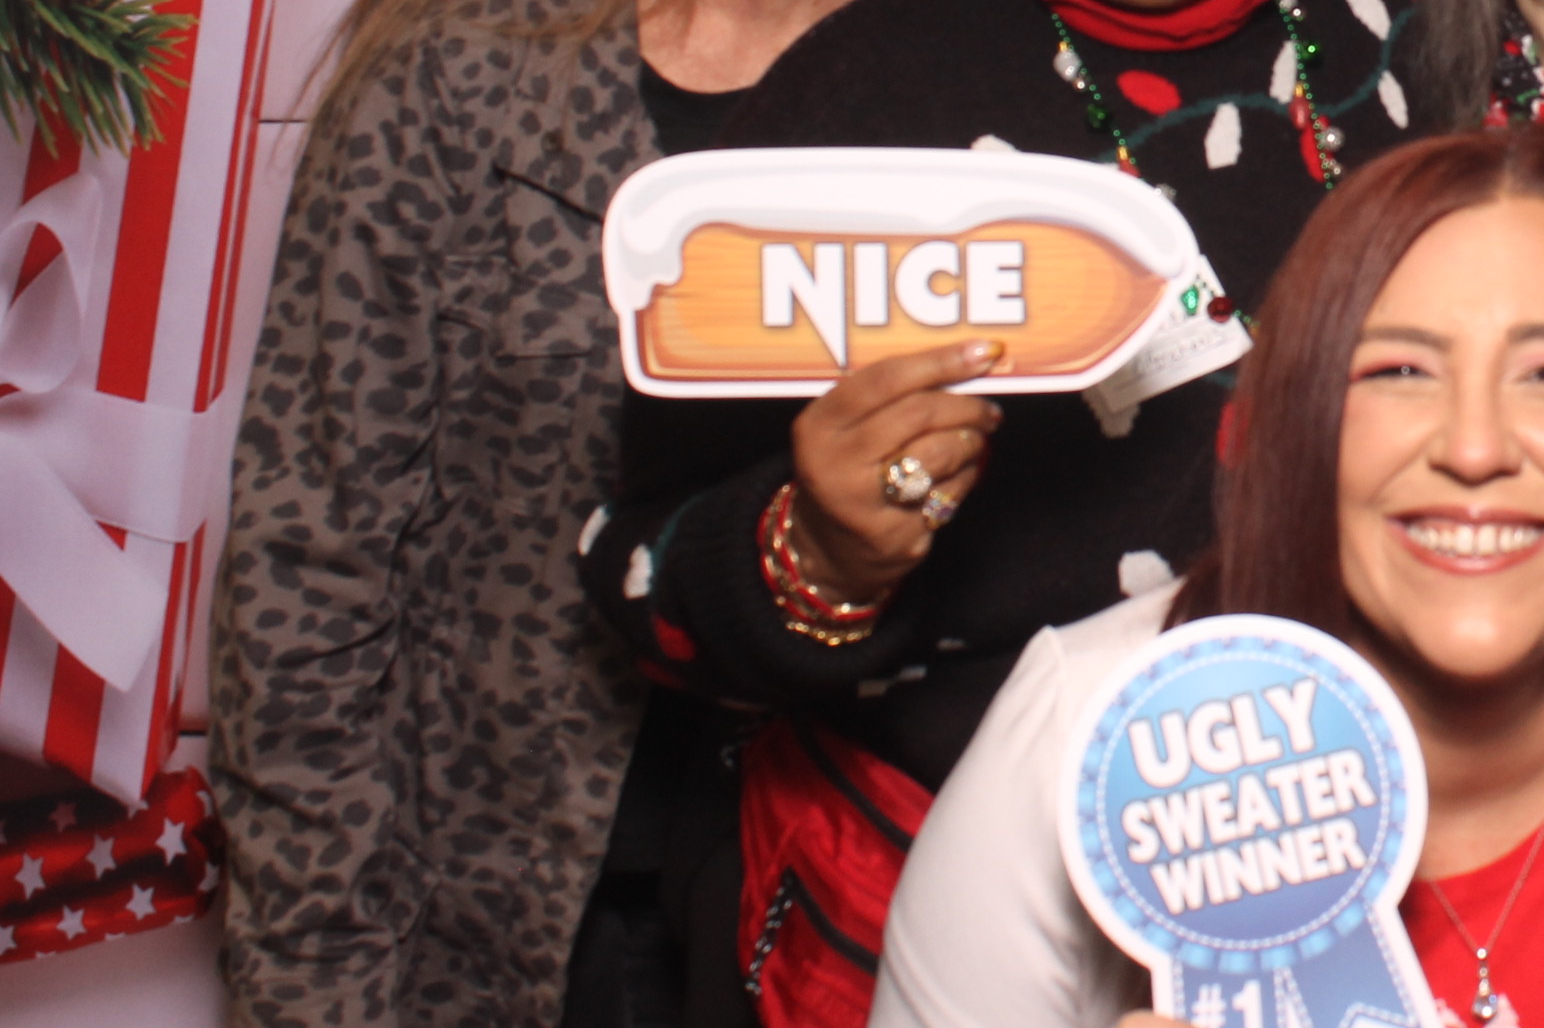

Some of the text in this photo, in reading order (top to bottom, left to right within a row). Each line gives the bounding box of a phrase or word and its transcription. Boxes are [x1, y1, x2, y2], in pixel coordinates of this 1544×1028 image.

[761, 240, 1026, 368] NICE
[1127, 676, 1319, 789] UGLY
[1121, 748, 1377, 864] SWEATER
[1149, 817, 1367, 916] WINNER
[1191, 979, 1264, 1028] #1
